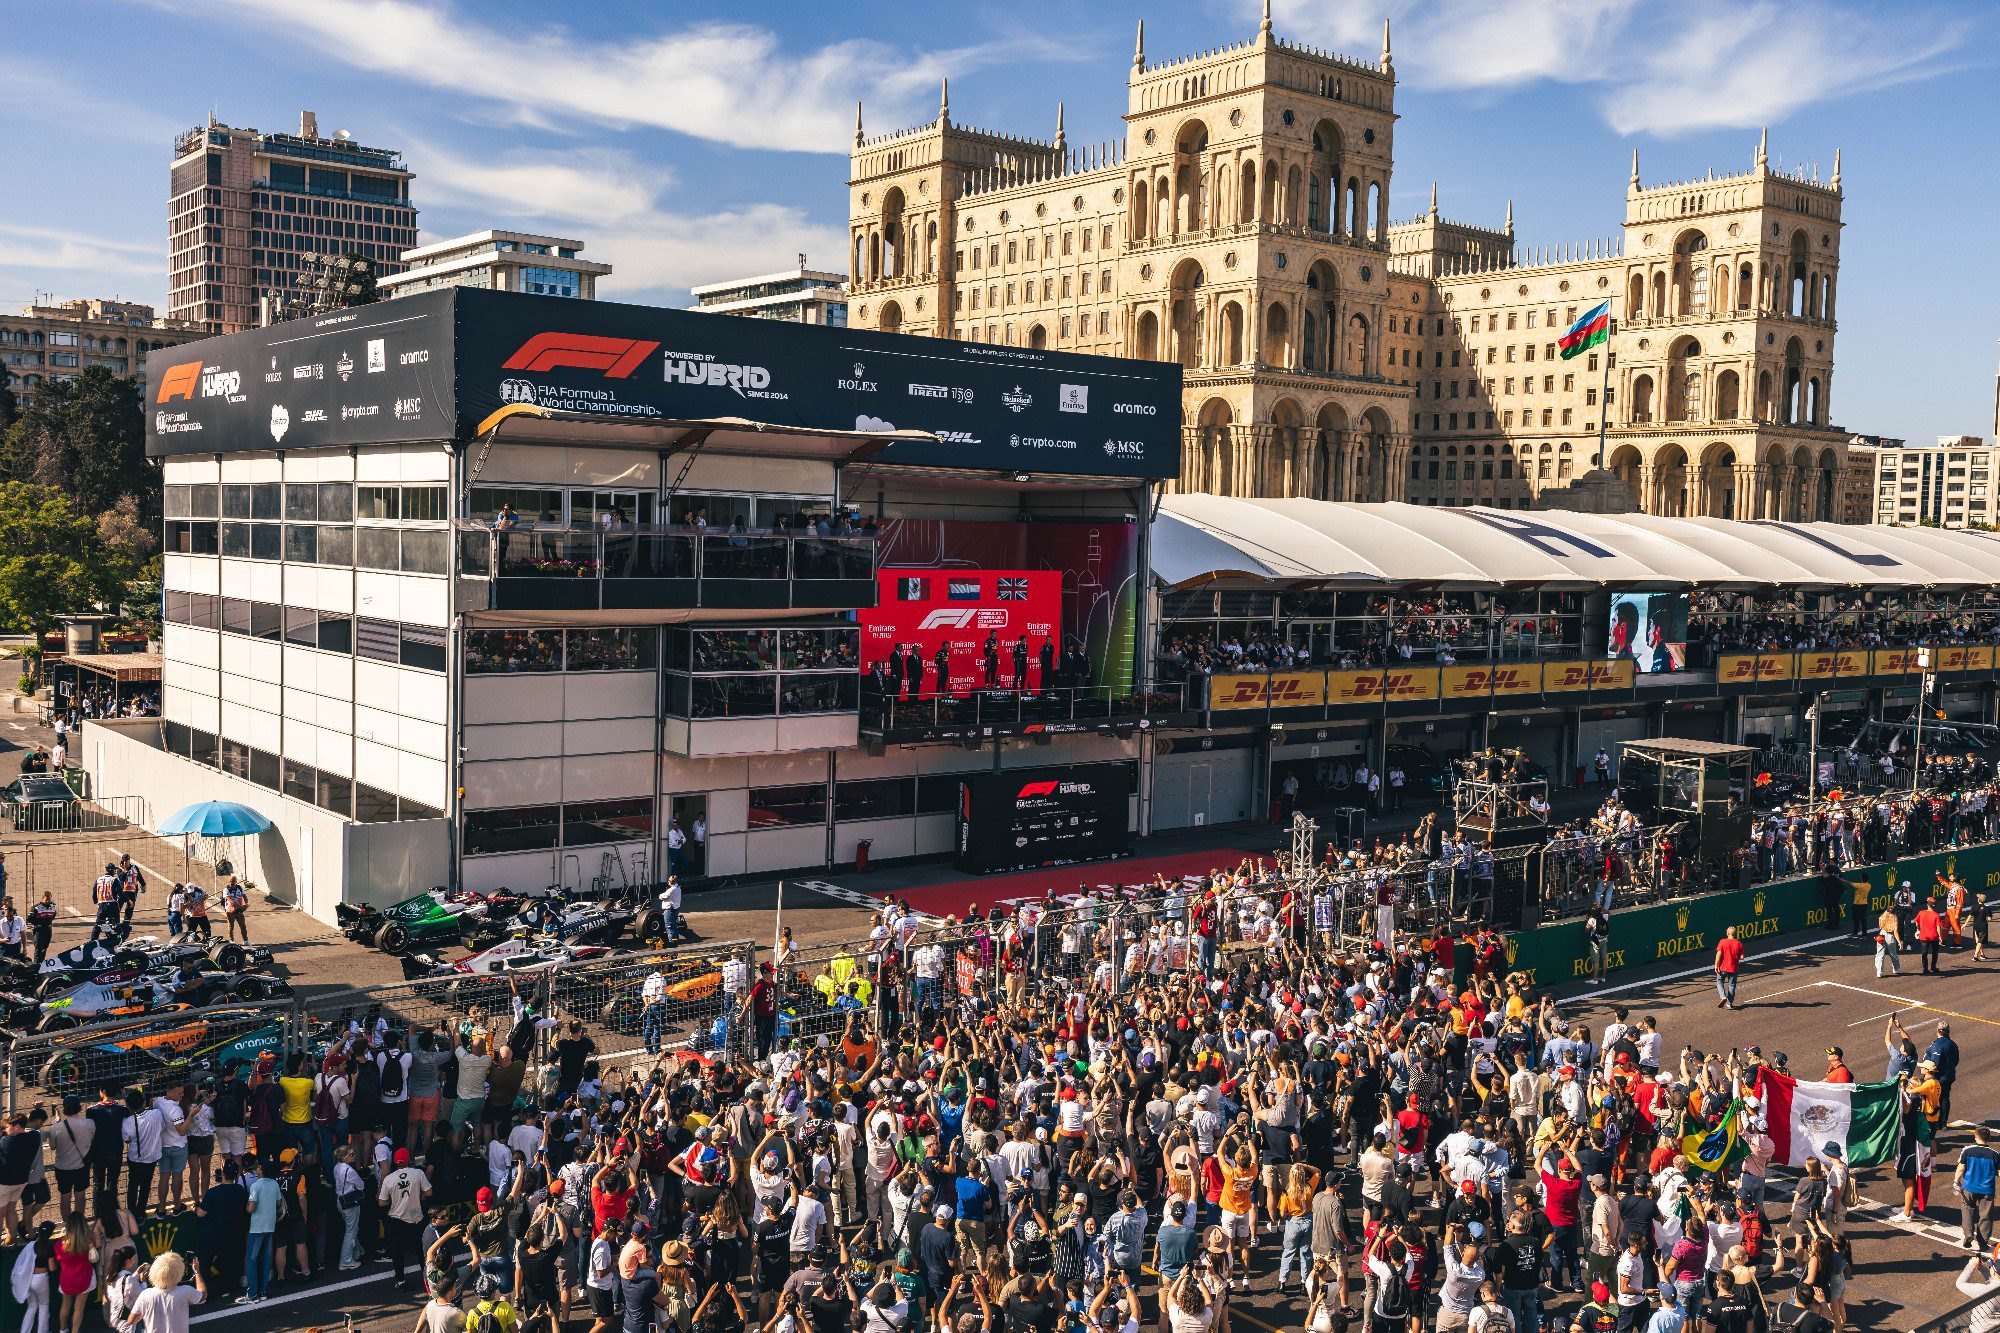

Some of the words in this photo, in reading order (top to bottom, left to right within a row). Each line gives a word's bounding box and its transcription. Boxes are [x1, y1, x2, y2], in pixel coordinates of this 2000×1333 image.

[401, 350, 428, 364] aramco
[501, 332, 661, 378] F1
[664, 350, 704, 360] POWERED
[664, 359, 771, 398] HYBRID
[837, 378, 878, 392] ROLEX
[538, 385, 557, 397] FIA
[560, 387, 607, 399] Formula
[610, 391, 616, 400] 1
[747, 390, 769, 398] SINCE
[770, 392, 788, 400] 2014
[908, 383, 949, 398] PIRELLI
[403, 397, 420, 413] MSC
[538, 397, 574, 409] World
[1113, 402, 1156, 415] aramco
[348, 405, 379, 418] crypto.com
[1023, 435, 1077, 448] crypto.com
[1117, 440, 1144, 453] MSC
[917, 608, 978, 629] F1
[1027, 622, 1051, 630] Emirates
[1816, 656, 1853, 673] DHL
[1948, 651, 1980, 667] DHL
[1563, 666, 1615, 686] DHL
[1734, 659, 1777, 677] DHL
[1352, 674, 1415, 697] DHL
[1464, 669, 1520, 691] DHL
[1233, 679, 1302, 703] DHL
[1871, 893, 1897, 911] ROL
[1736, 916, 1780, 940] ROLEX
[1656, 932, 1705, 958] ROLEX
[45, 958, 56, 967] 10
[1573, 950, 1626, 976] ROEX
[235, 1036, 278, 1050] aramco
